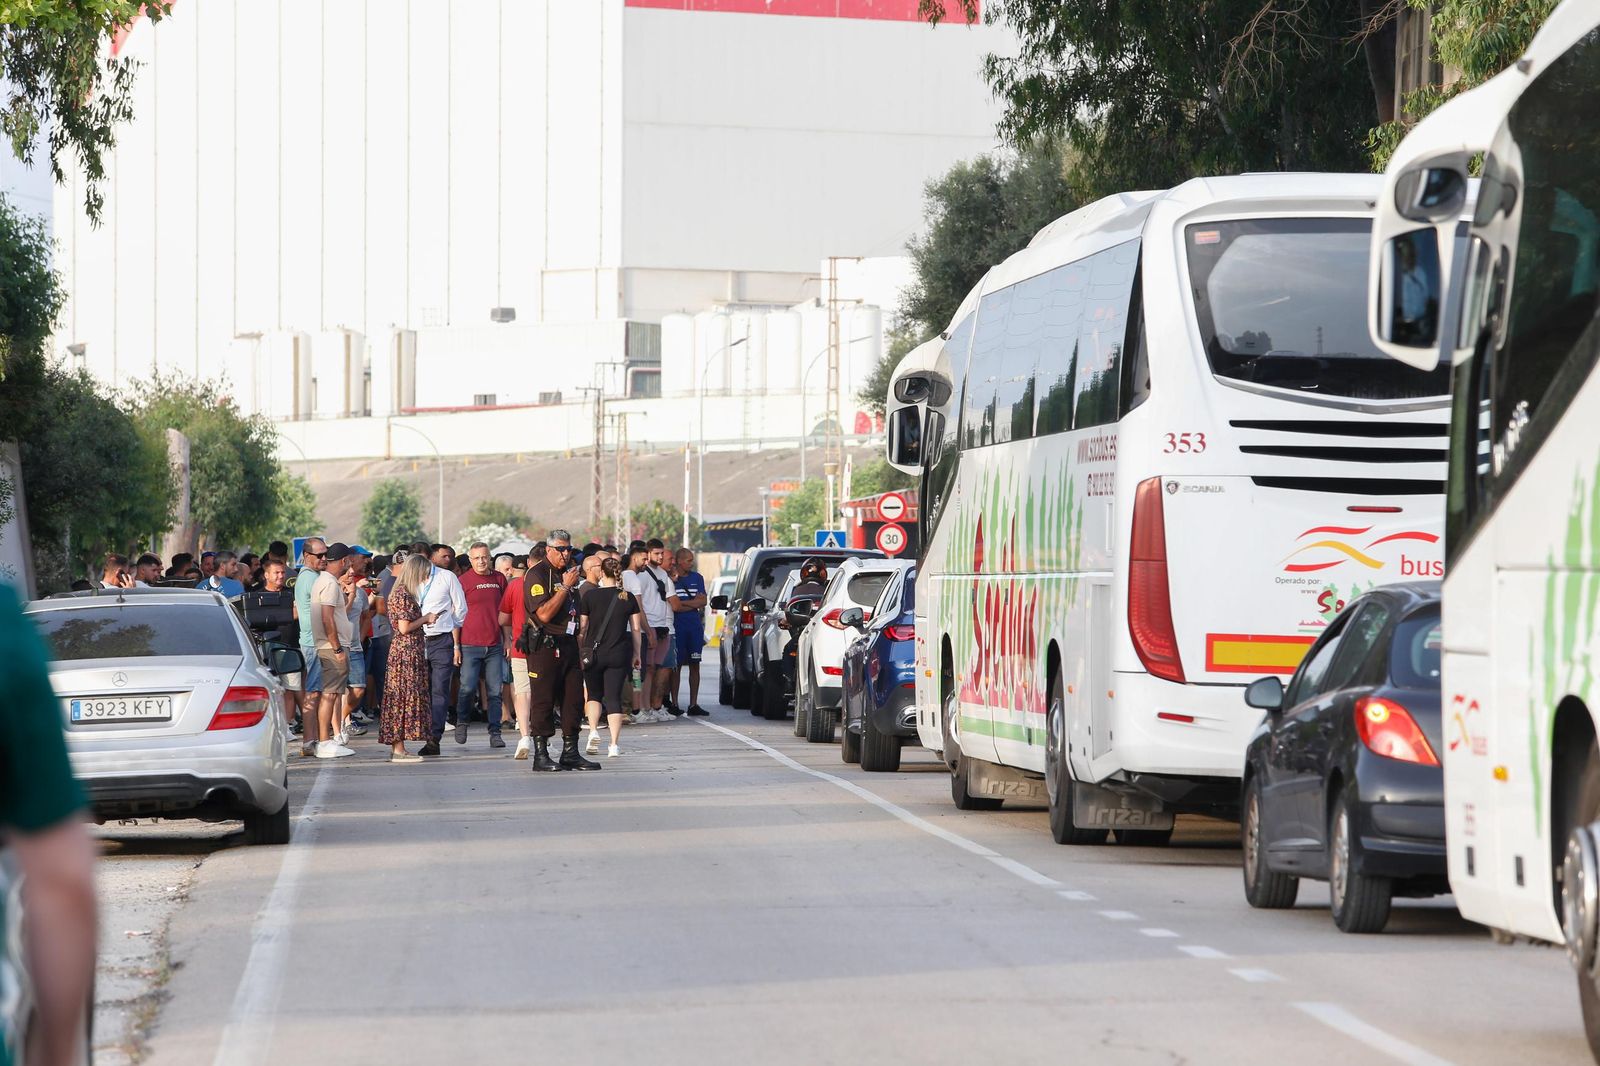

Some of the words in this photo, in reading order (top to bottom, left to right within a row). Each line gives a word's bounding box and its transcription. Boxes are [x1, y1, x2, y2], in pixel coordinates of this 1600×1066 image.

[1163, 432, 1207, 454] 353
[1183, 485, 1225, 493] SCANIA
[884, 533, 899, 545] 30
[1275, 577, 1306, 585] Operado
[1307, 577, 1322, 586] por:
[84, 702, 127, 718] 3923
[133, 699, 164, 716] KFY
[980, 777, 1040, 797] Irizar
[1088, 805, 1155, 826] Irizar
